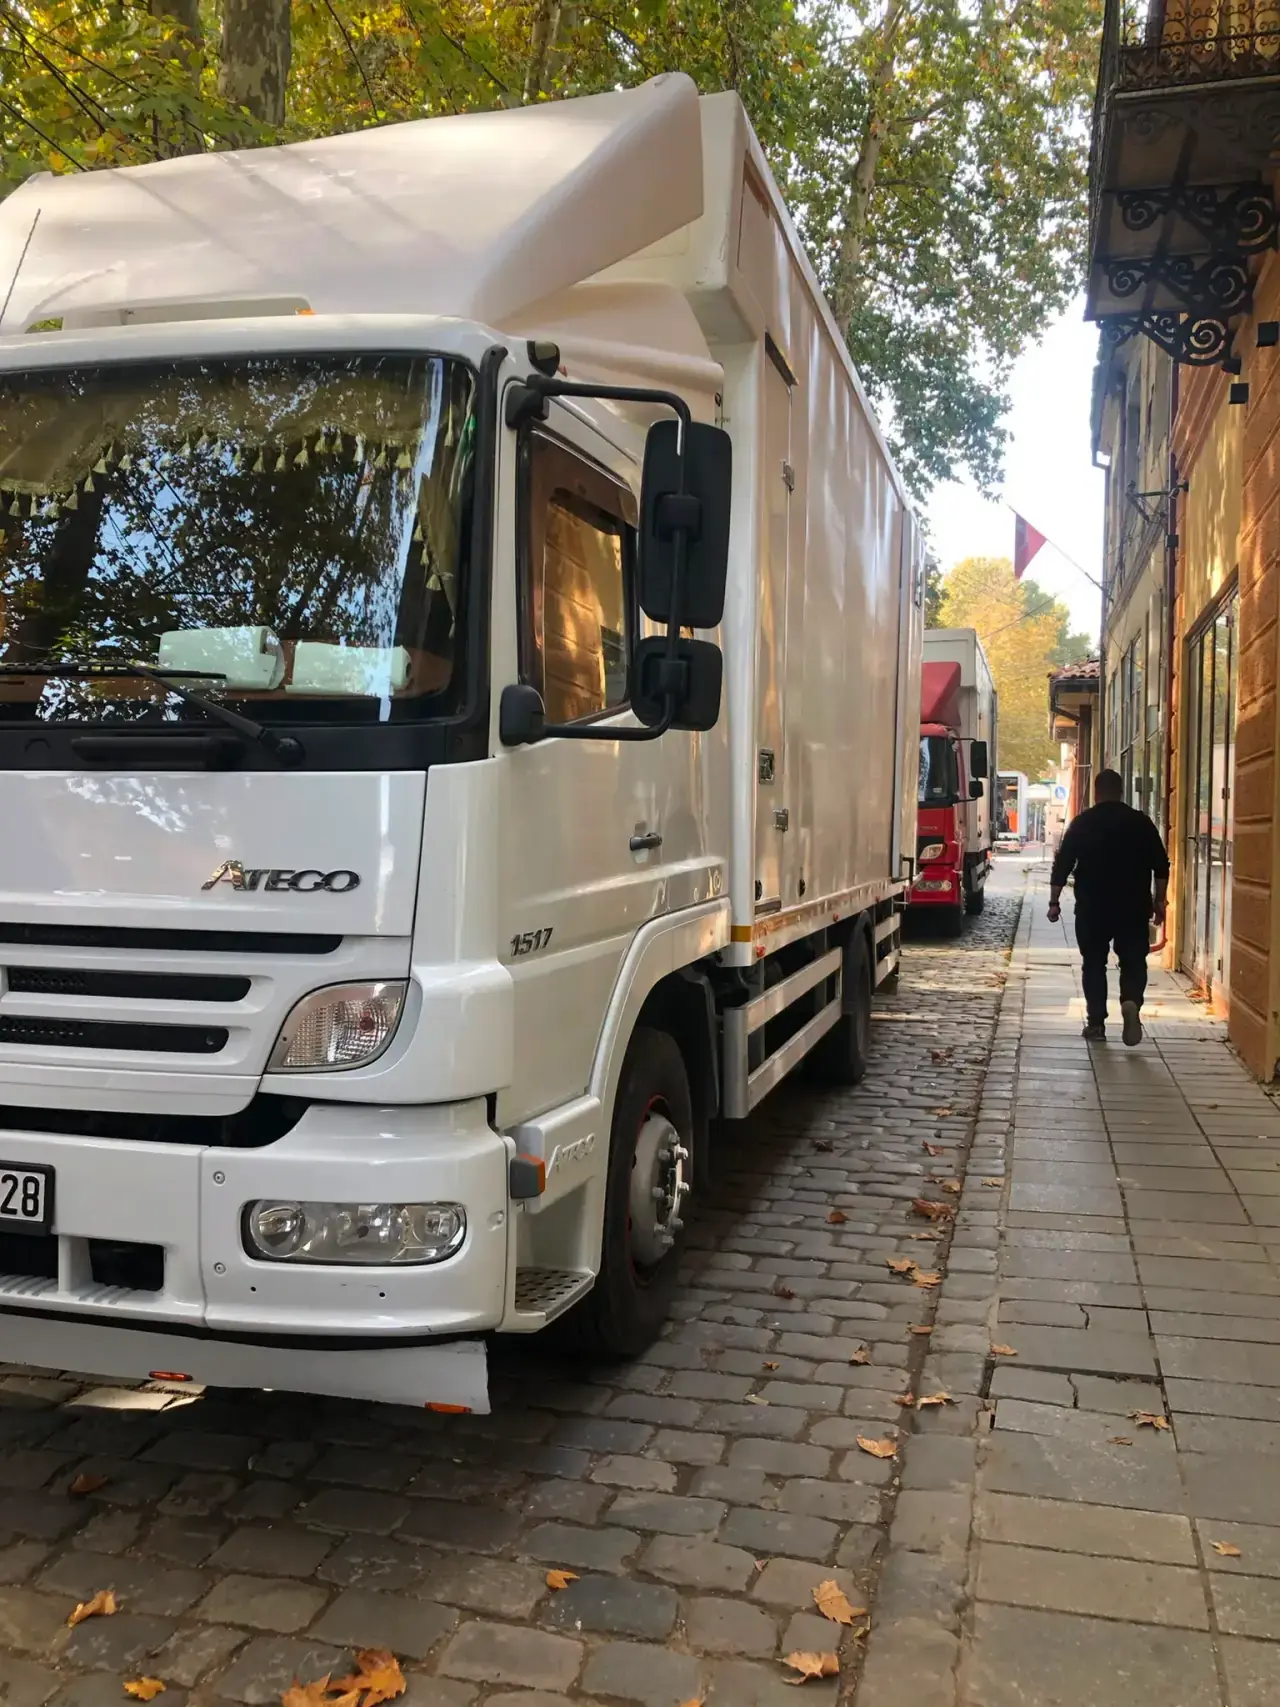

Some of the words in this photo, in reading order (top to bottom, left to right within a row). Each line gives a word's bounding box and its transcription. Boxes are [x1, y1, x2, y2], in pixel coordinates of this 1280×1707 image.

[201, 859, 361, 892] ATEGO
[510, 926, 554, 957] 1517
[0, 1173, 40, 1217] 28
